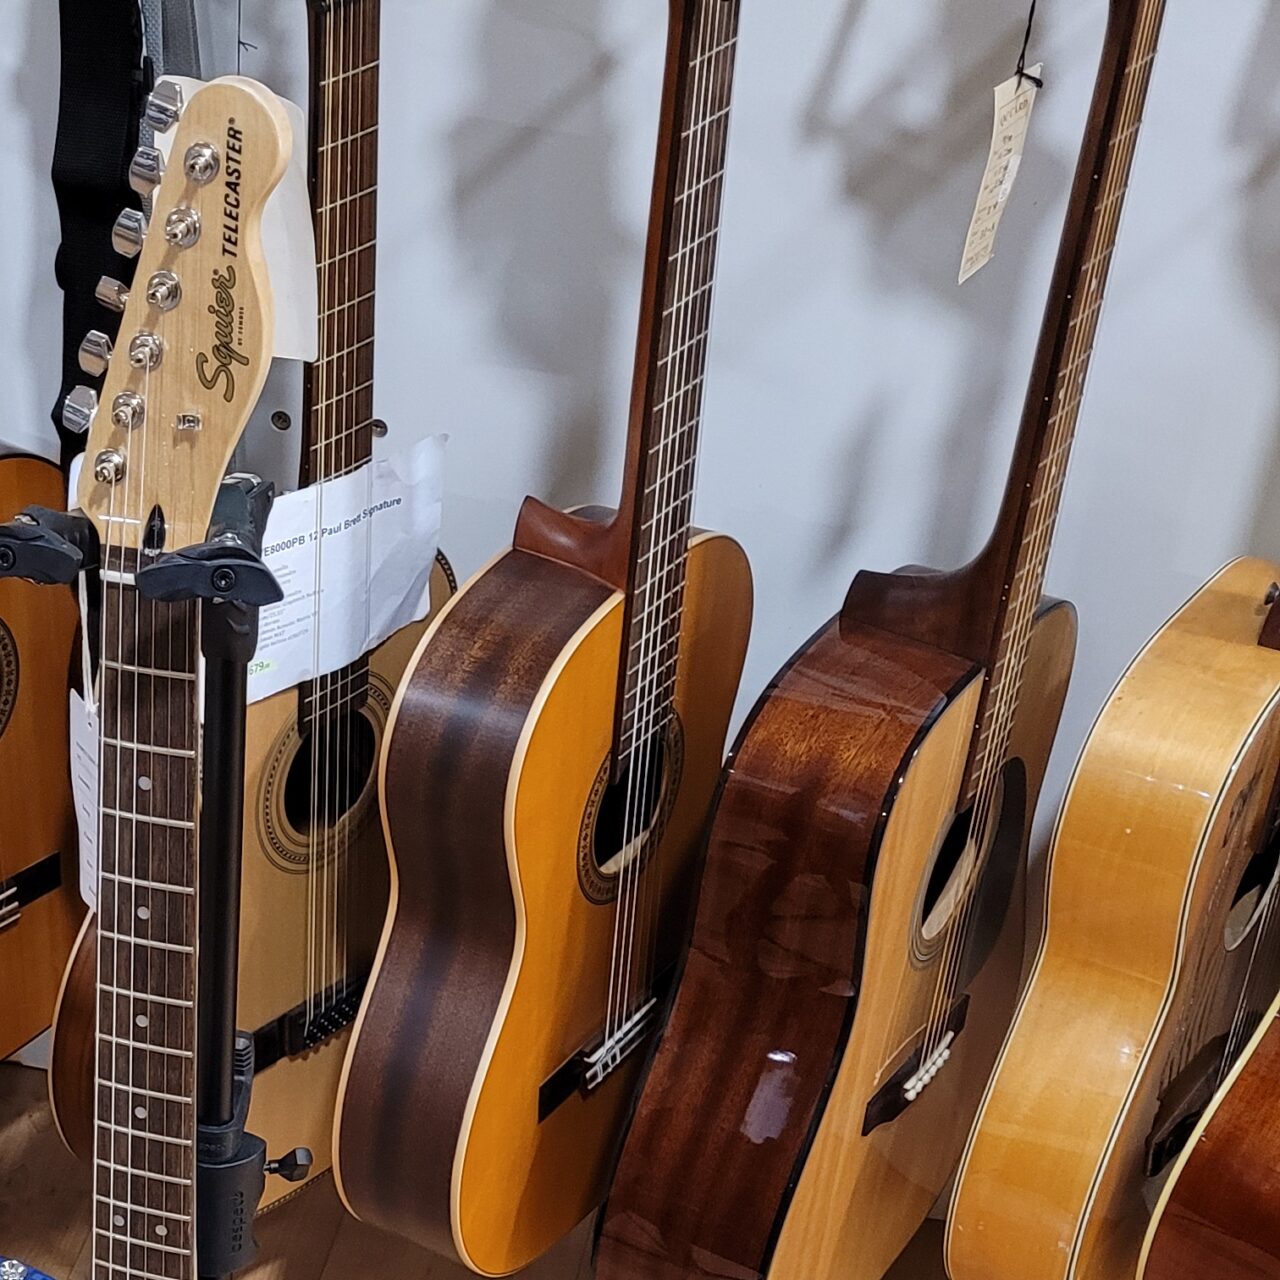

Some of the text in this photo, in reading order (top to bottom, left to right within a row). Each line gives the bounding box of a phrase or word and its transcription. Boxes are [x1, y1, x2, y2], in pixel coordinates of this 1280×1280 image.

[196, 264, 250, 403] Squier
[263, 534, 306, 557] E8000PB
[321, 522, 342, 538] Paul
